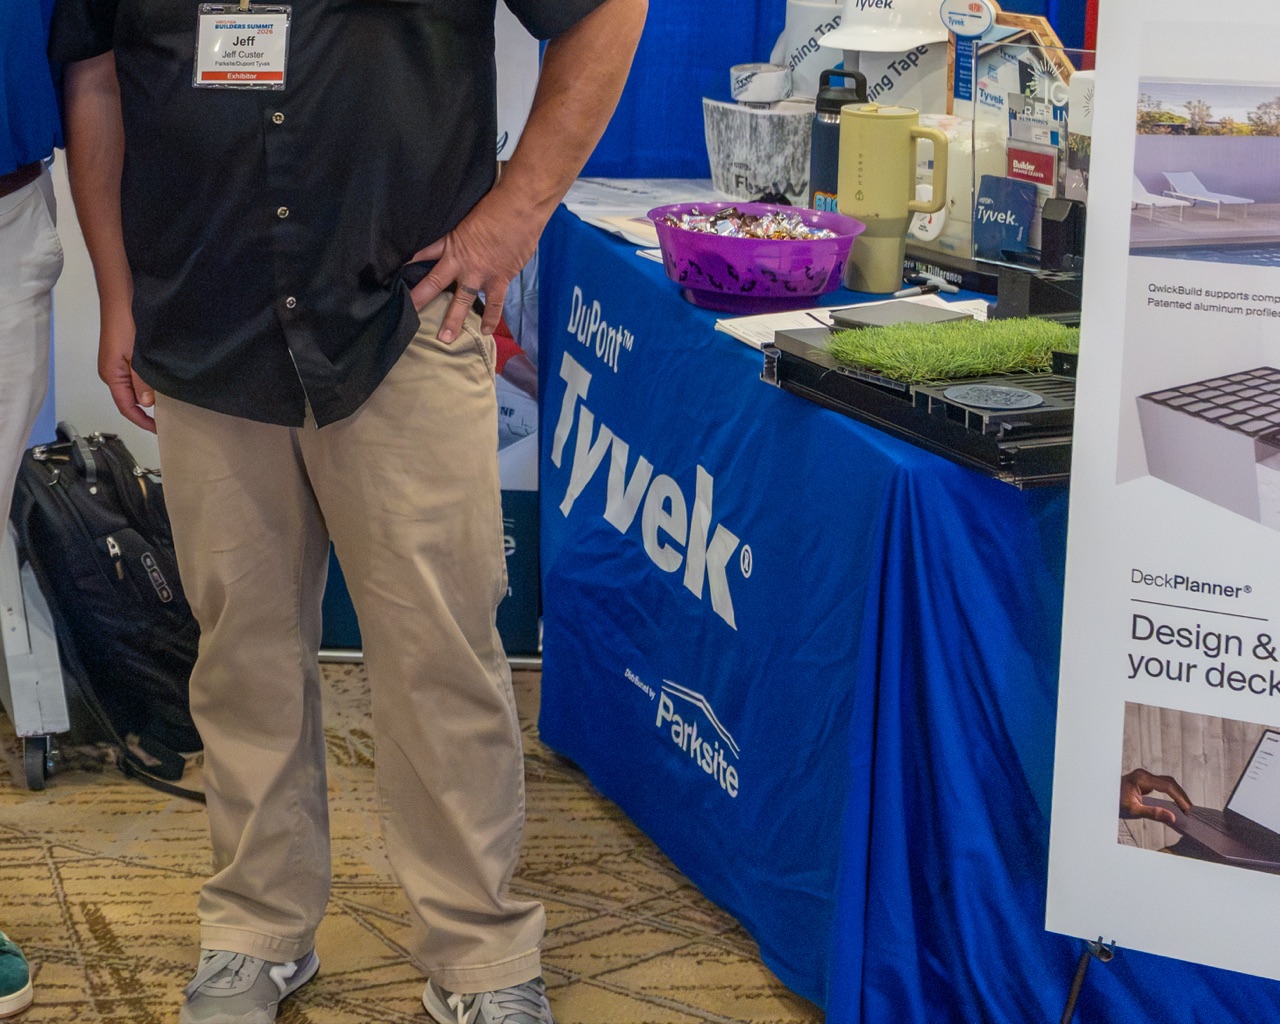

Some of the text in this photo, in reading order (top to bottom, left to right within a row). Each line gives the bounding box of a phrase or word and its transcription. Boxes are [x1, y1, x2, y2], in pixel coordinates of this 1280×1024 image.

[233, 36, 256, 46] Jeff
[887, 44, 928, 75] Tape
[979, 87, 1004, 105] Tyvek
[977, 205, 1016, 226] Tyvek
[1148, 283, 1202, 296] QwickBuild
[1205, 289, 1249, 301] supports
[1148, 297, 1192, 310] Patented
[1194, 302, 1243, 315] aluminum
[1131, 614, 1278, 662] Design &
[1128, 653, 1280, 696] your deck
[649, 688, 656, 701] by
[656, 691, 739, 798] Parksite
